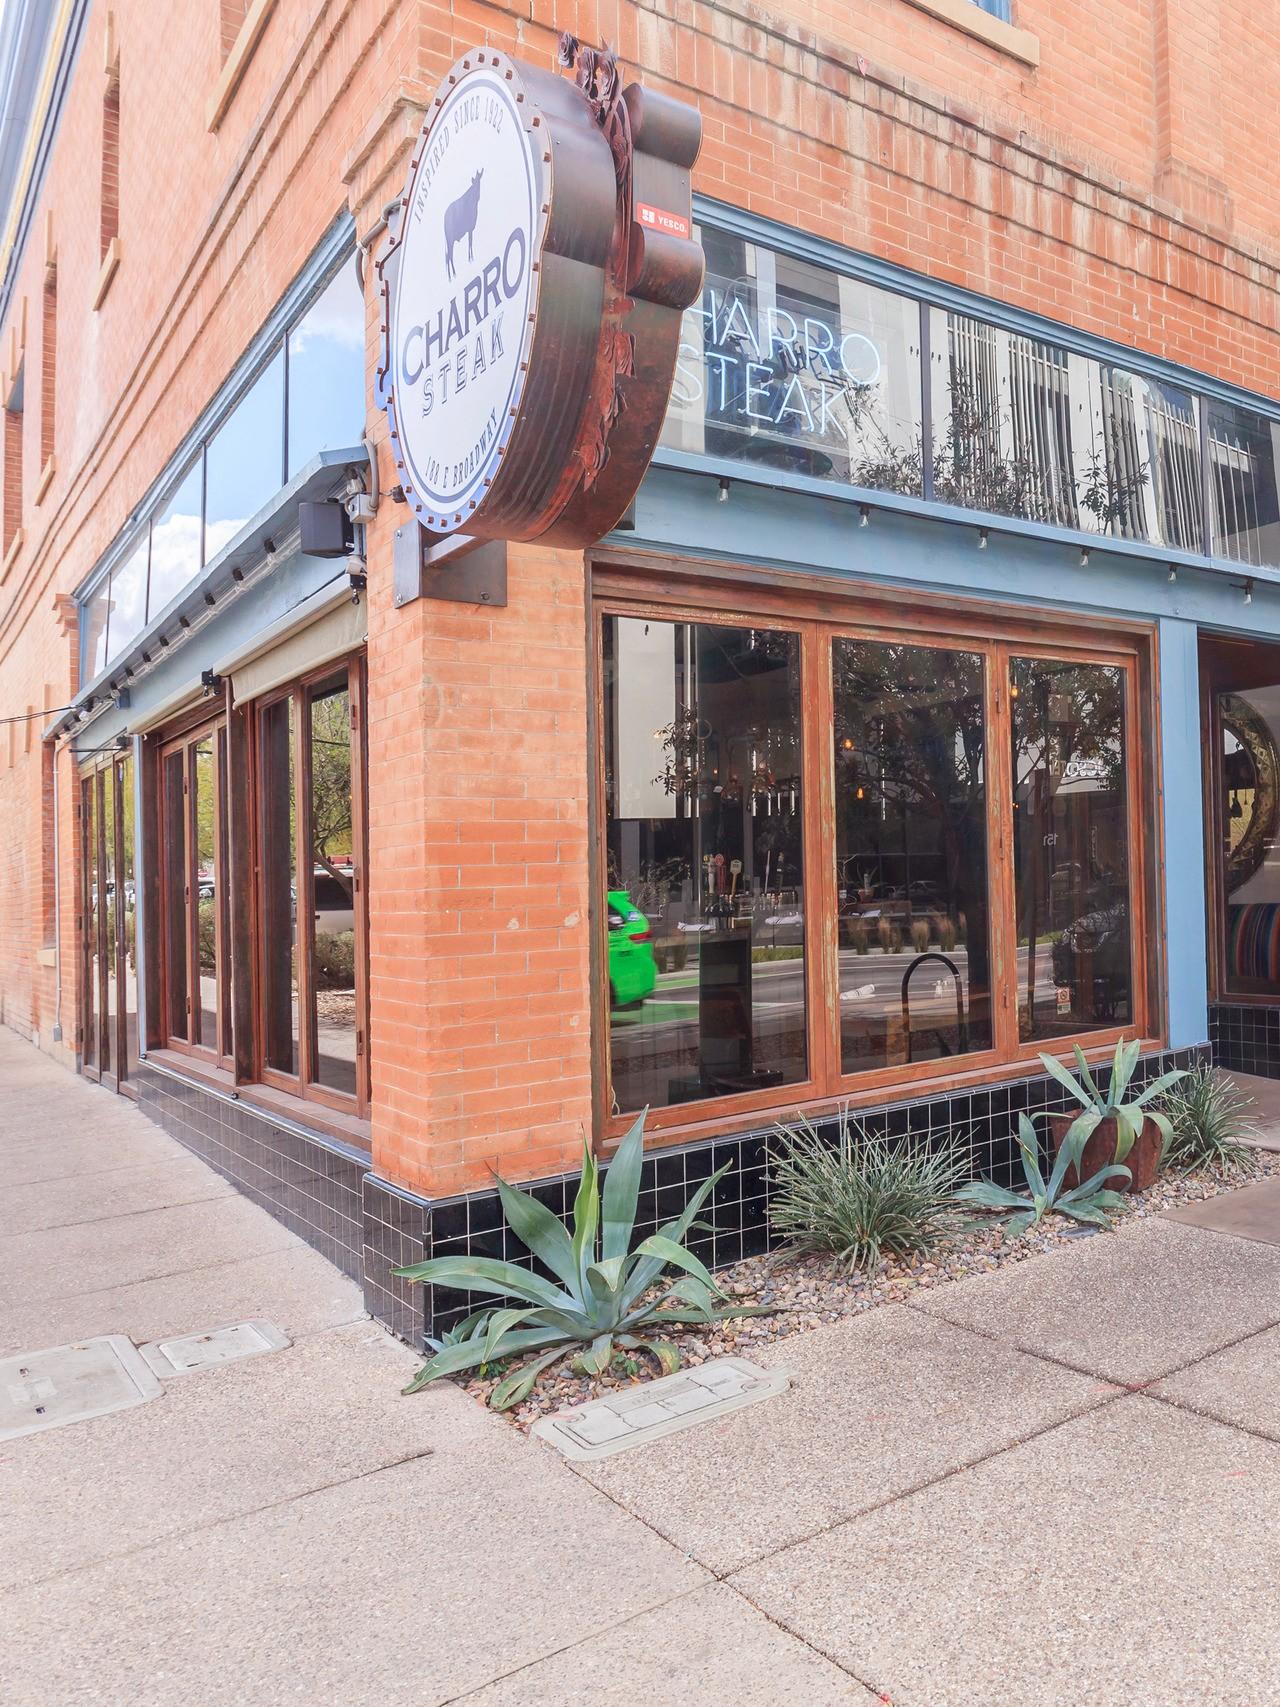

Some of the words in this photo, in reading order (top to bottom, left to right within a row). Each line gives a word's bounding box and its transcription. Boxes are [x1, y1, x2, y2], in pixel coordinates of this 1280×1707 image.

[415, 126, 450, 223] INSPIRED
[454, 95, 480, 134] SINCE
[484, 97, 504, 134] 1922
[402, 227, 526, 386] CHARRO
[681, 290, 881, 385] HARRO
[423, 311, 505, 418] STEAK
[671, 343, 848, 440] STEAK
[425, 455, 440, 485] 188
[443, 466, 449, 489] E
[453, 405, 498, 488] BROADWAY
